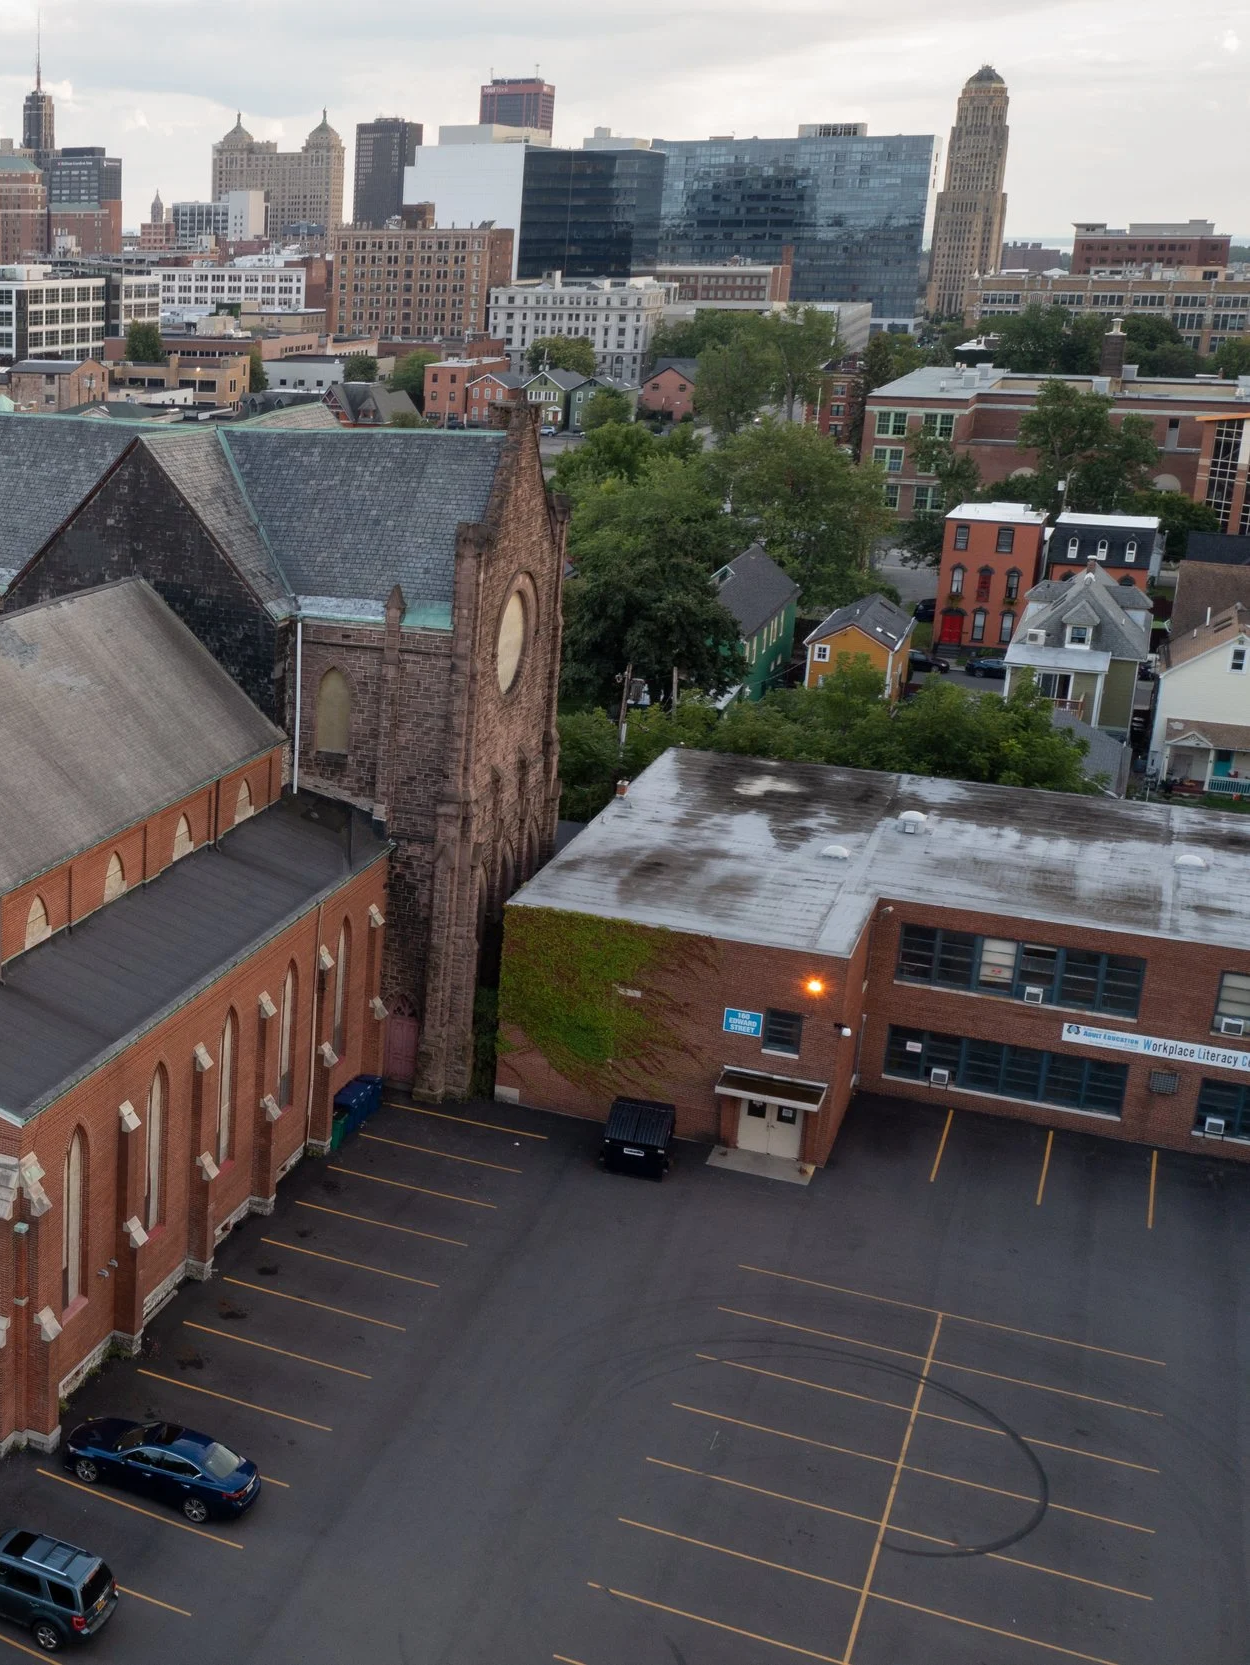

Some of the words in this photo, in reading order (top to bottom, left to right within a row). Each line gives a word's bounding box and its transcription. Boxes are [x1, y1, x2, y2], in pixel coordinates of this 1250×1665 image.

[729, 1017, 757, 1028] EDWARD
[730, 1023, 755, 1033] STREET
[1143, 1038, 1195, 1057] Workplace
[1197, 1047, 1238, 1067] Literacy
